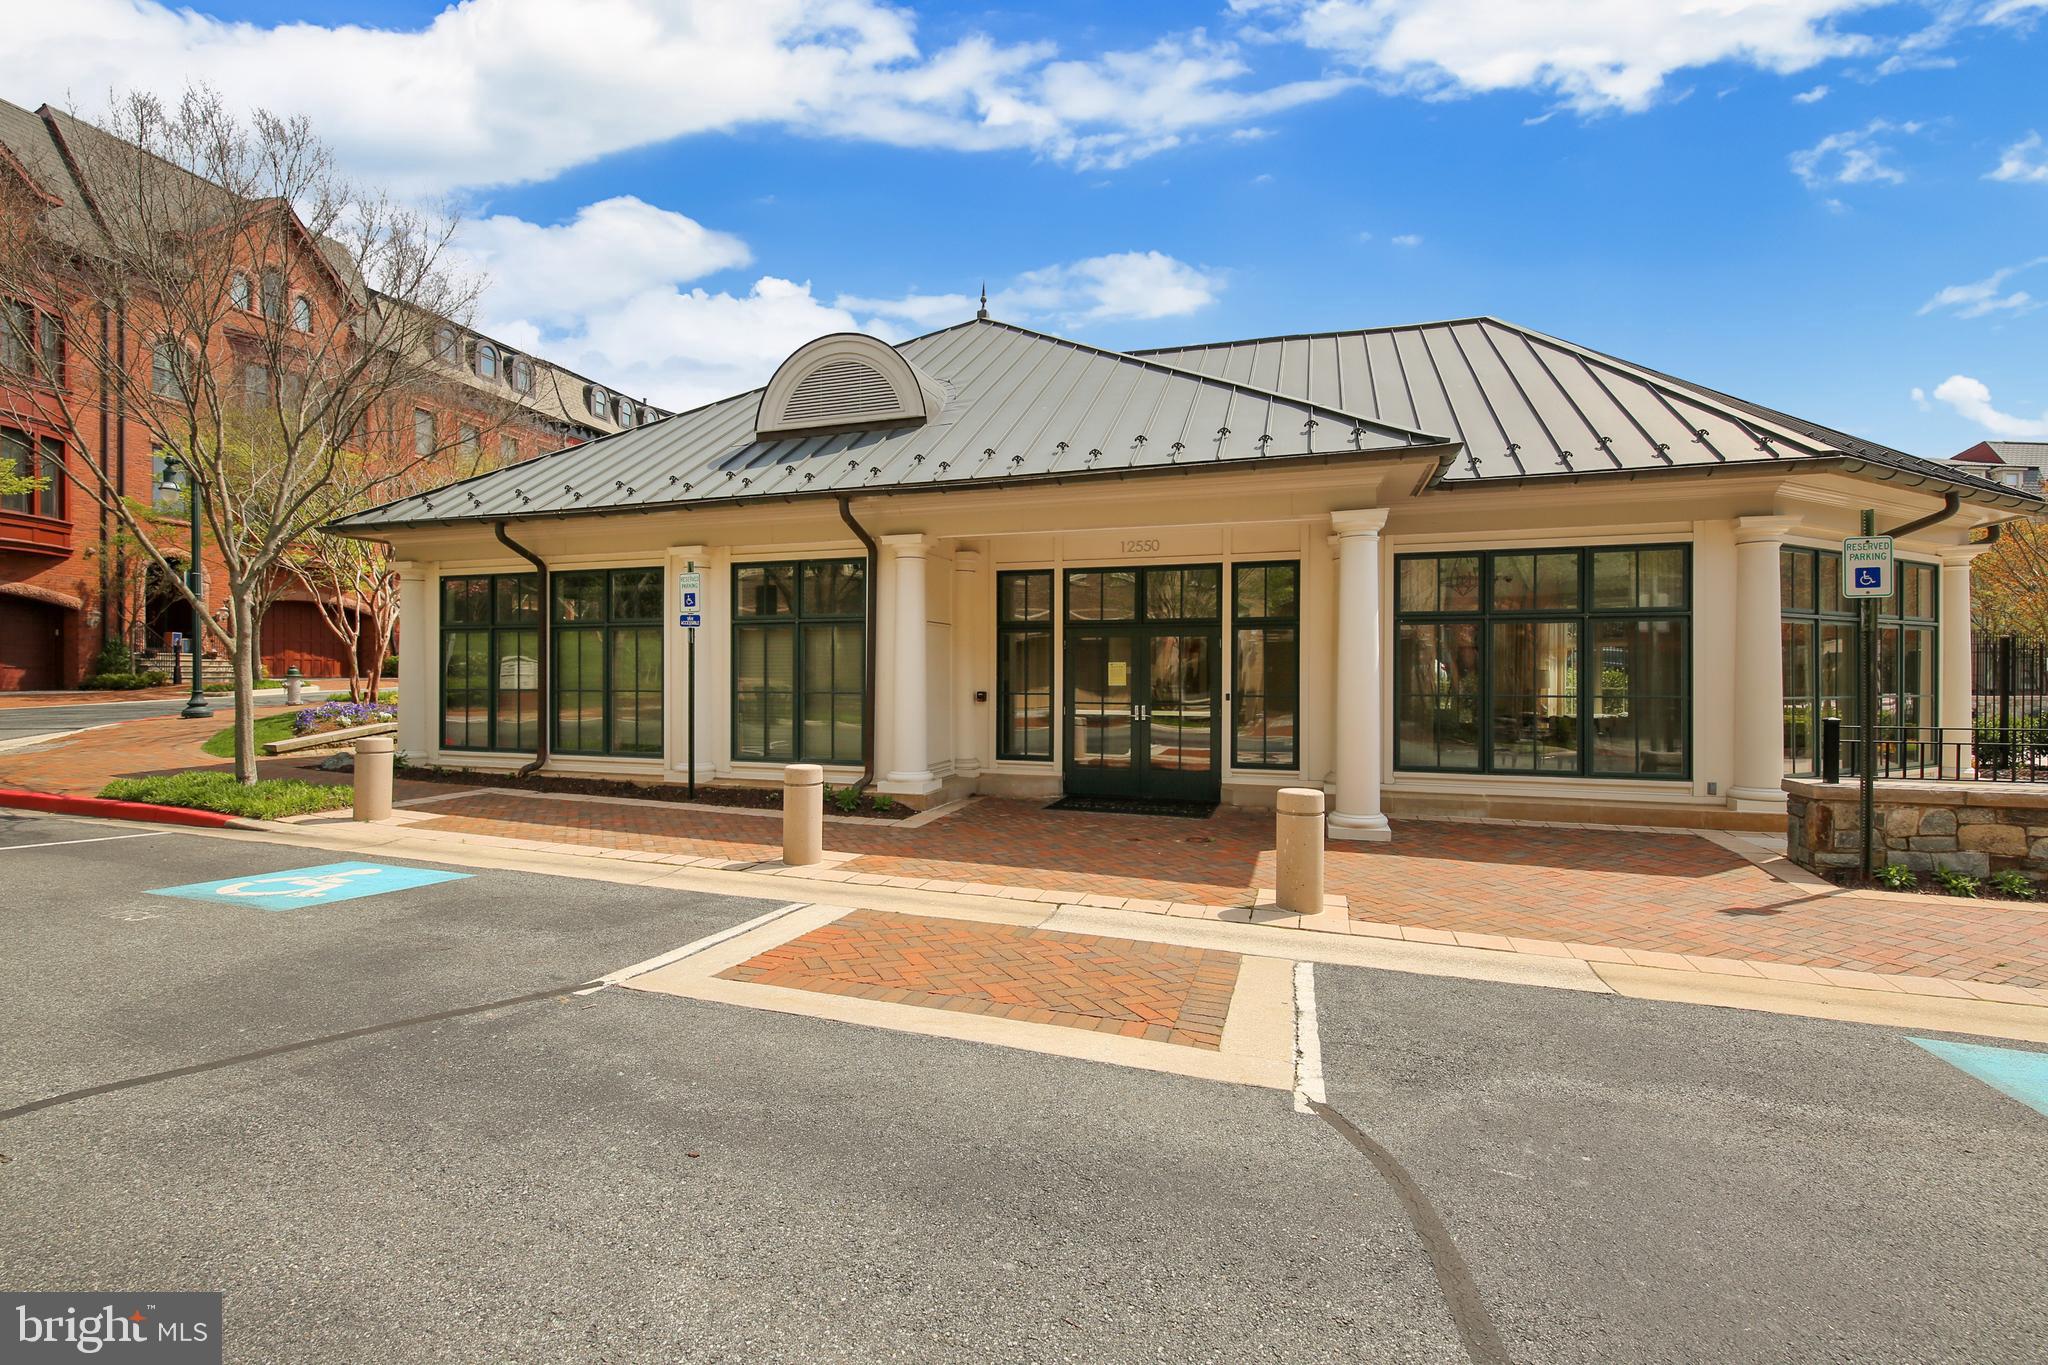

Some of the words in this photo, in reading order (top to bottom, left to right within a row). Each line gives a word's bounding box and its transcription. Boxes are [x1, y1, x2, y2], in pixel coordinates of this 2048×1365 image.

[1120, 539, 1160, 552] 12550
[1846, 541, 1890, 551] RESERVED
[1849, 552, 1887, 561] PARKING
